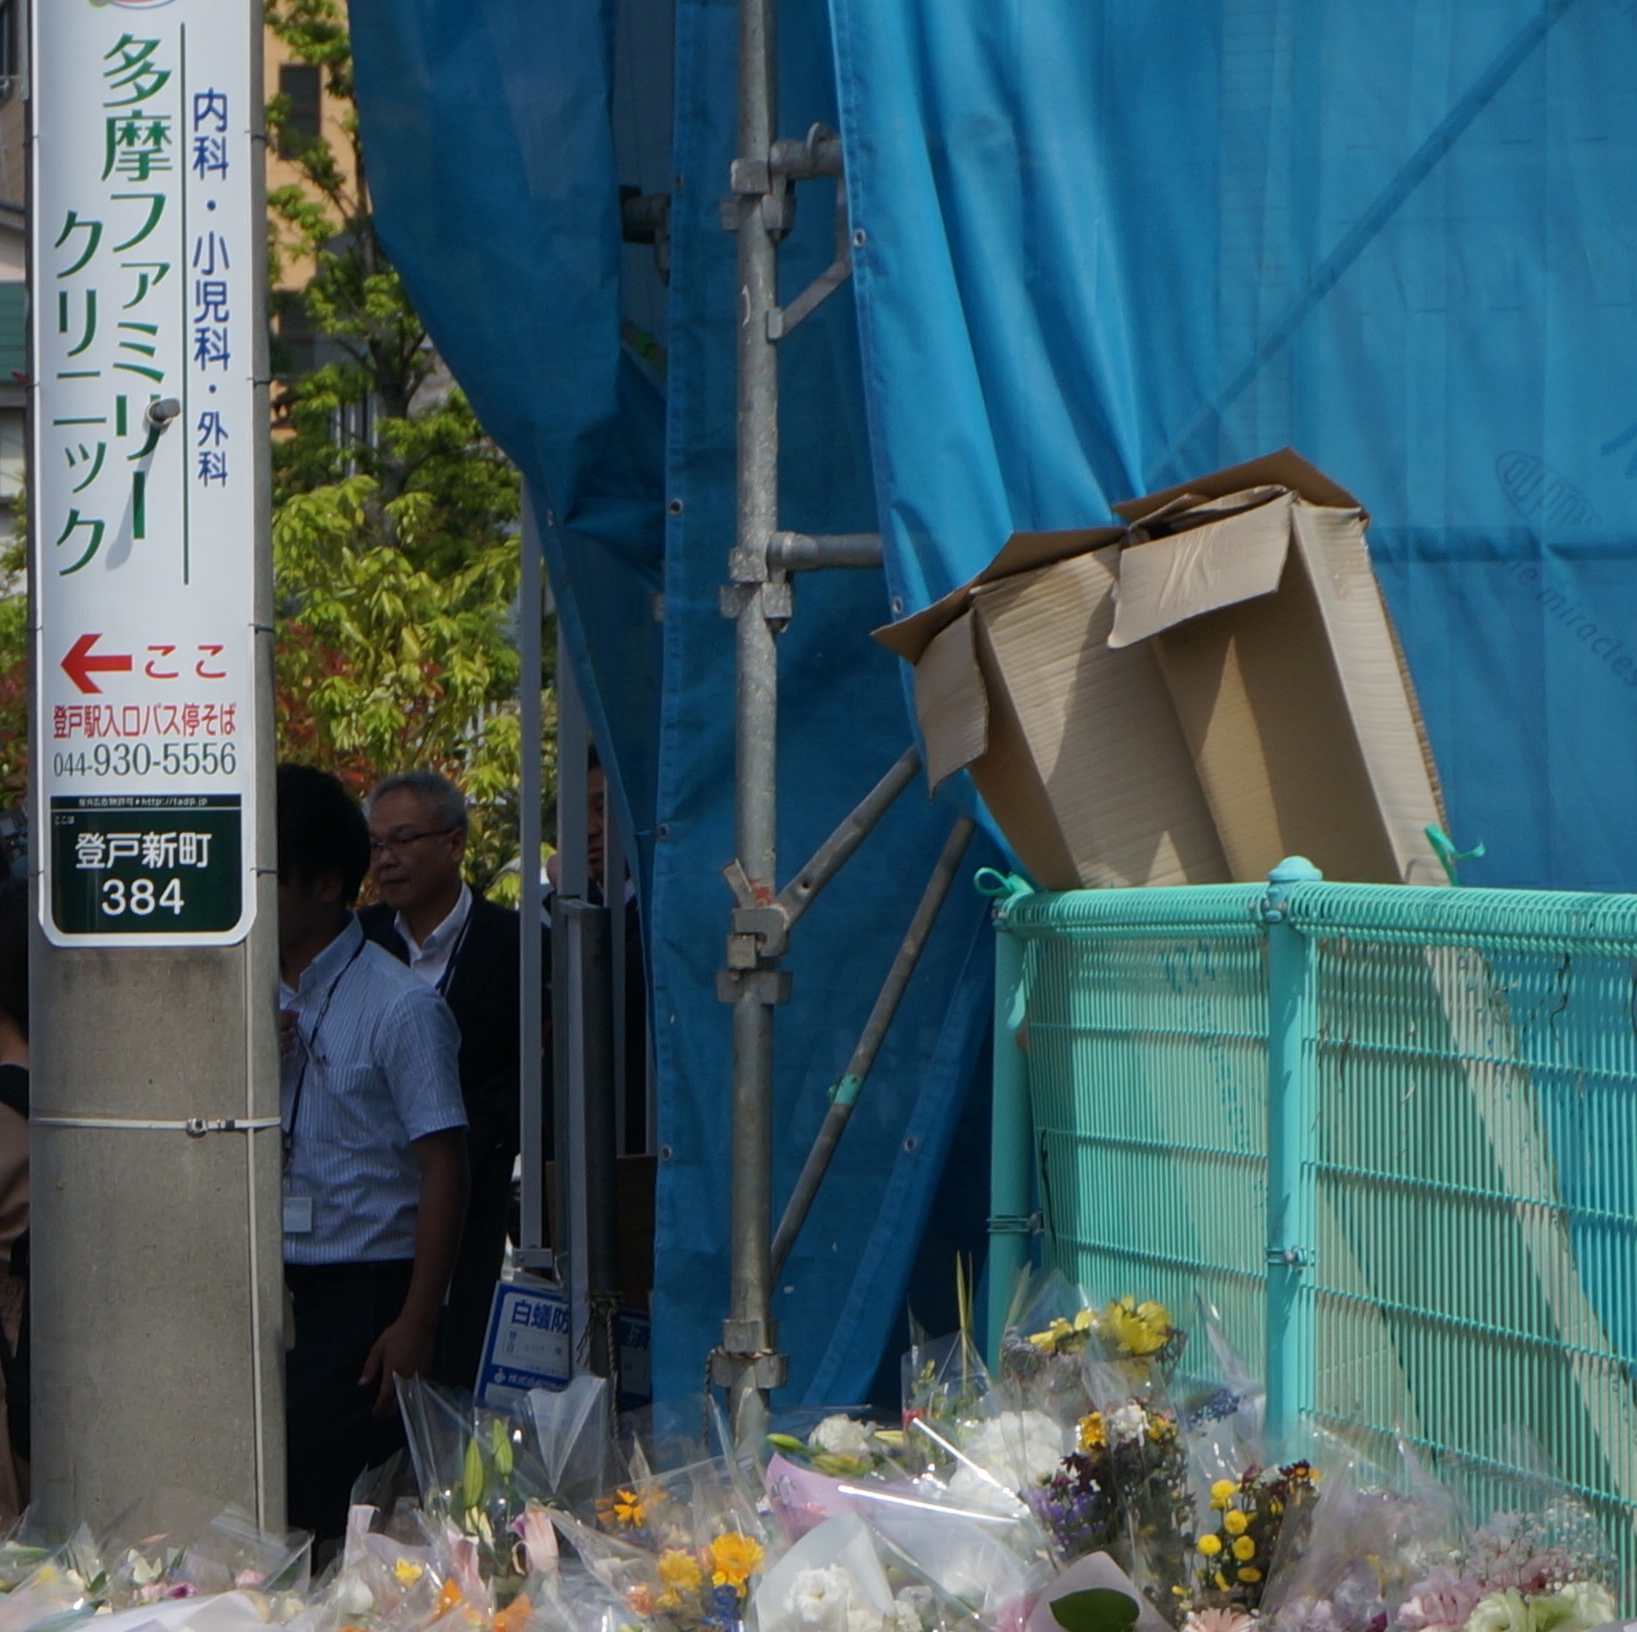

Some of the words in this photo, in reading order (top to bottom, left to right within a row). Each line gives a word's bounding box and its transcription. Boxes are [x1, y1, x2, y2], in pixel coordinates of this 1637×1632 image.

[101, 33, 172, 539] 多摩ファミリー
[192, 88, 230, 488] 内科・小児科・外科
[53, 210, 106, 576] クリニック
[145, 645, 227, 679] ここ
[53, 703, 237, 739] 登戸駅入口バス停そば
[53, 742, 237, 777] 044-930-5556
[75, 831, 213, 870] 登戸新町
[101, 878, 185, 916] 384
[511, 1299, 570, 1334] 白蟻防
